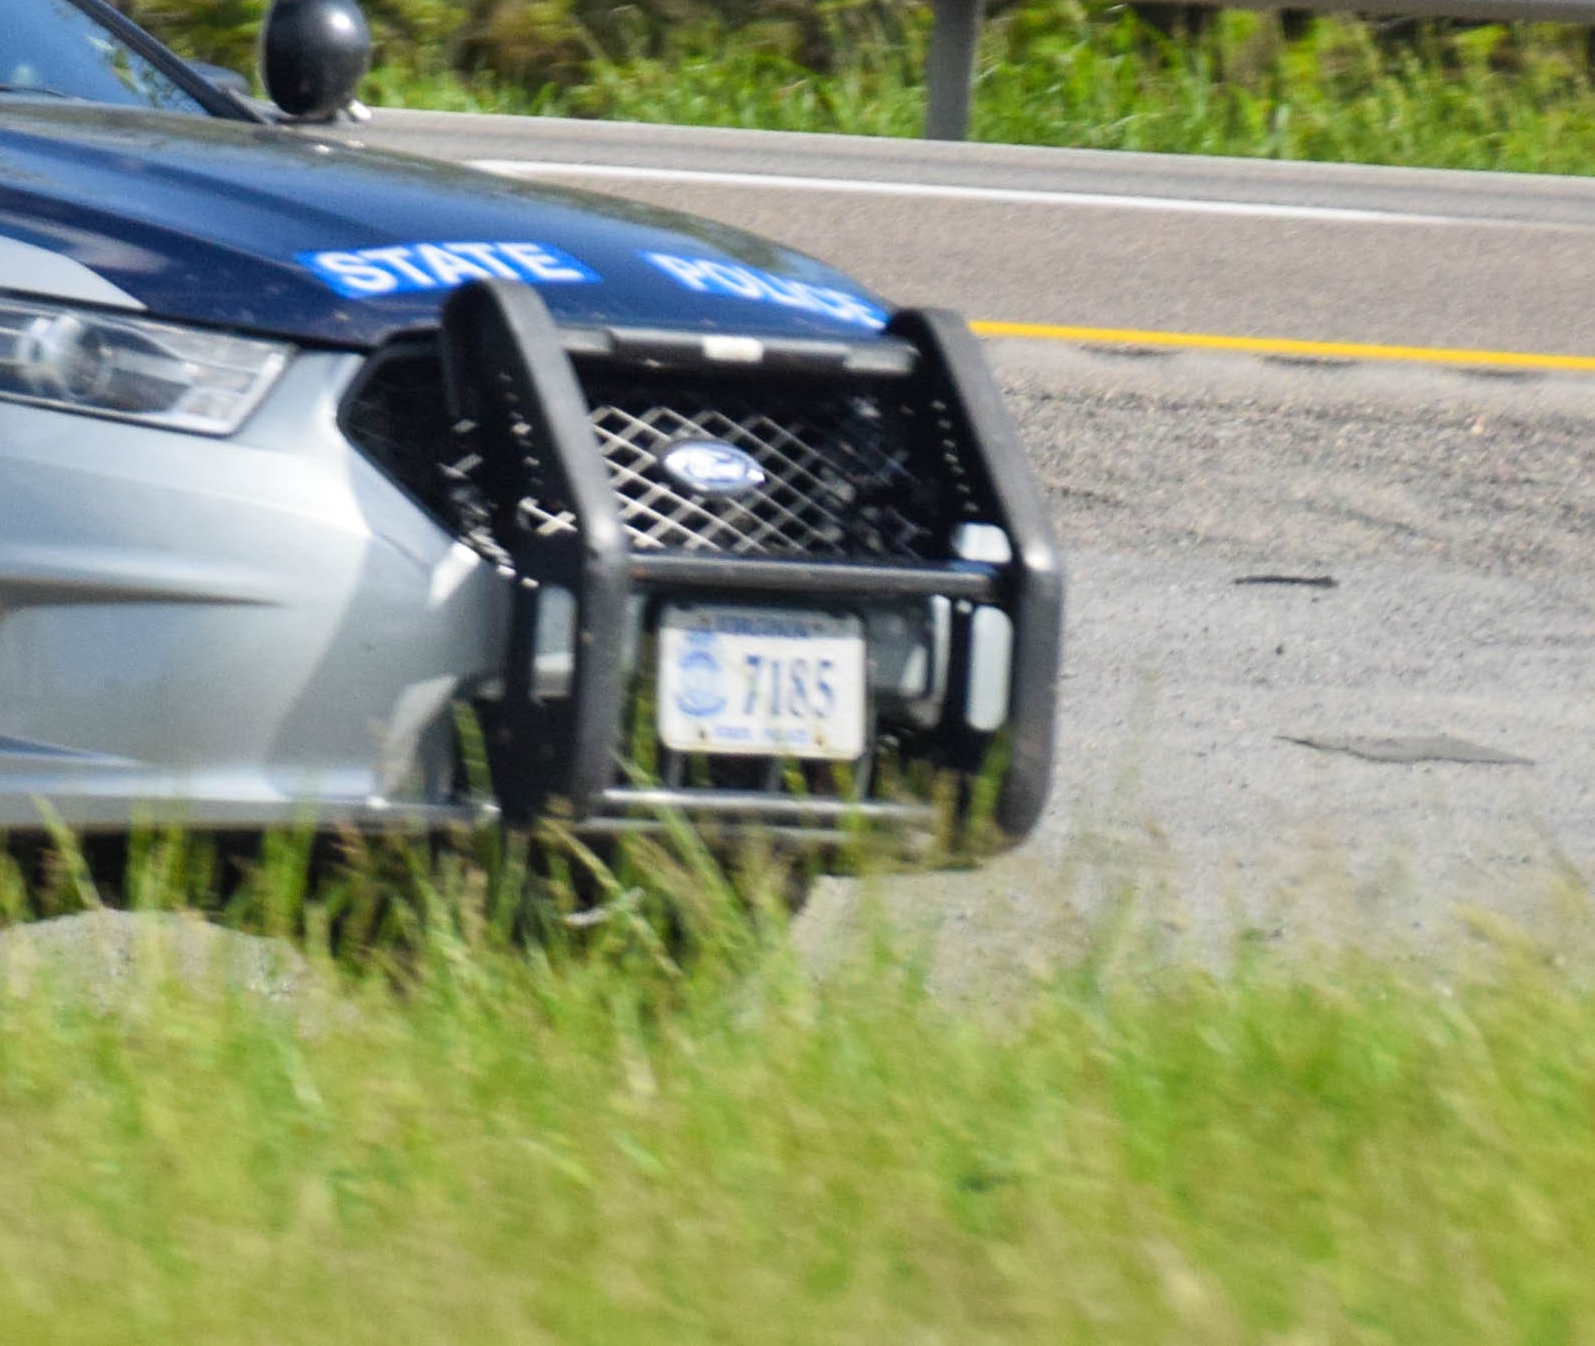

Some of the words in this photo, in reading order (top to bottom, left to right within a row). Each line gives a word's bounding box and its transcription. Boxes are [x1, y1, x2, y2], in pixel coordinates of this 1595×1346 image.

[315, 241, 585, 292] STATE
[649, 253, 887, 330] POLICE
[741, 653, 835, 719] 7185
